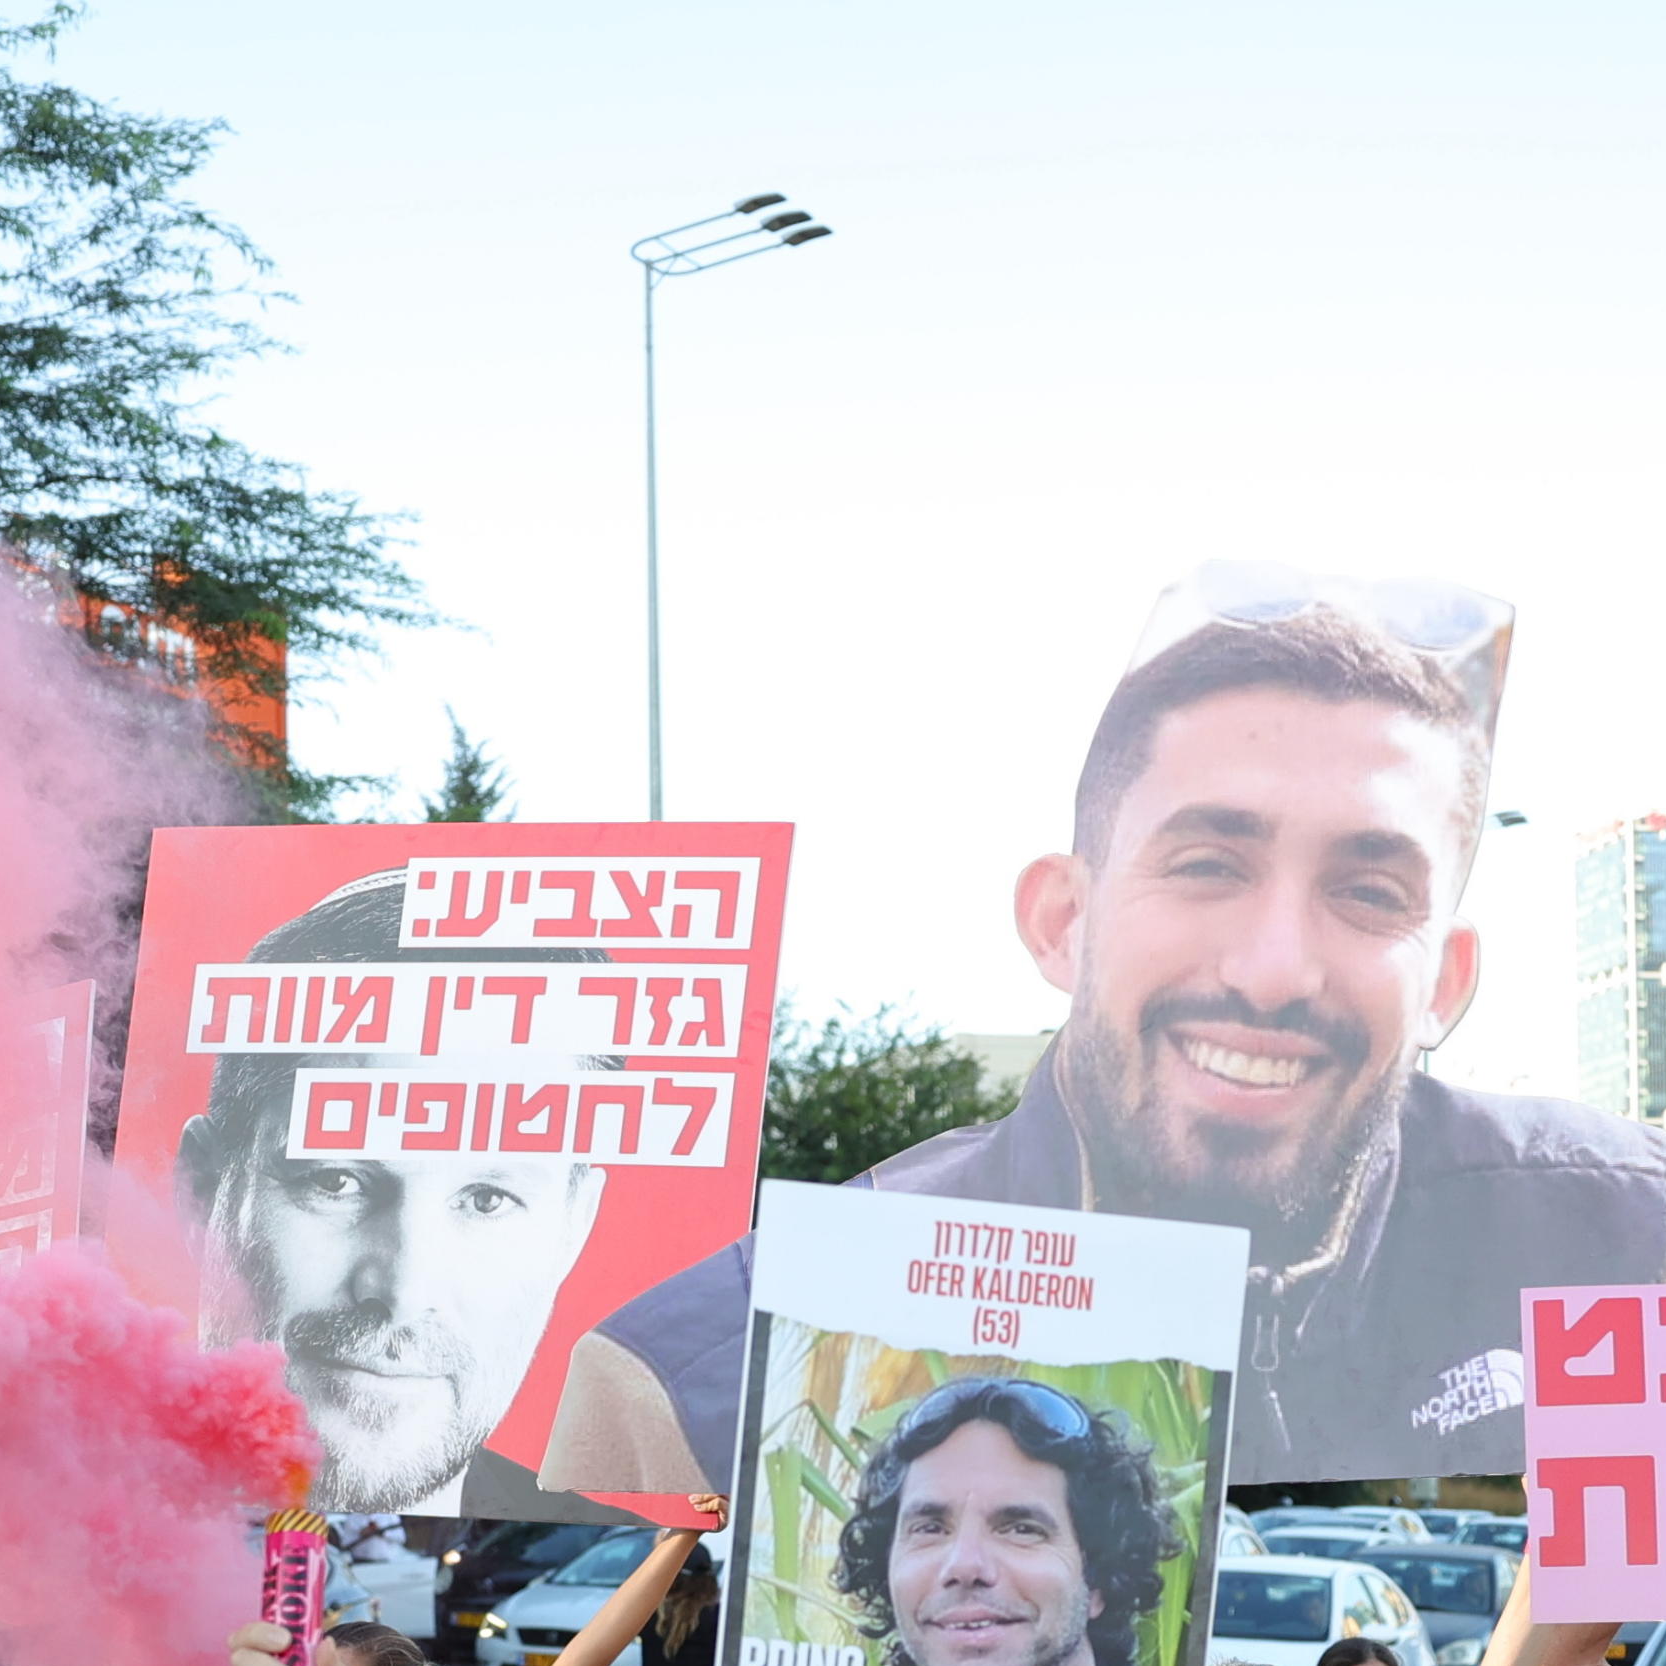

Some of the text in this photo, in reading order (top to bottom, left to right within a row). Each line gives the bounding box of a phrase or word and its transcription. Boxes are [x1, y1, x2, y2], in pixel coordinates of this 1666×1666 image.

[412, 870, 741, 938] הצביע:
[200, 976, 726, 1055] גזר דין מוות
[303, 1078, 717, 1156] לחטופים
[934, 1220, 1076, 1268] עופר קלדרון
[908, 1261, 1095, 1311] OFER KALDERON
[972, 1309, 1020, 1349] (53)
[1438, 1354, 1487, 1389] THE
[1411, 1374, 1493, 1429] NORTH
[1438, 1393, 1497, 1435] FACE
